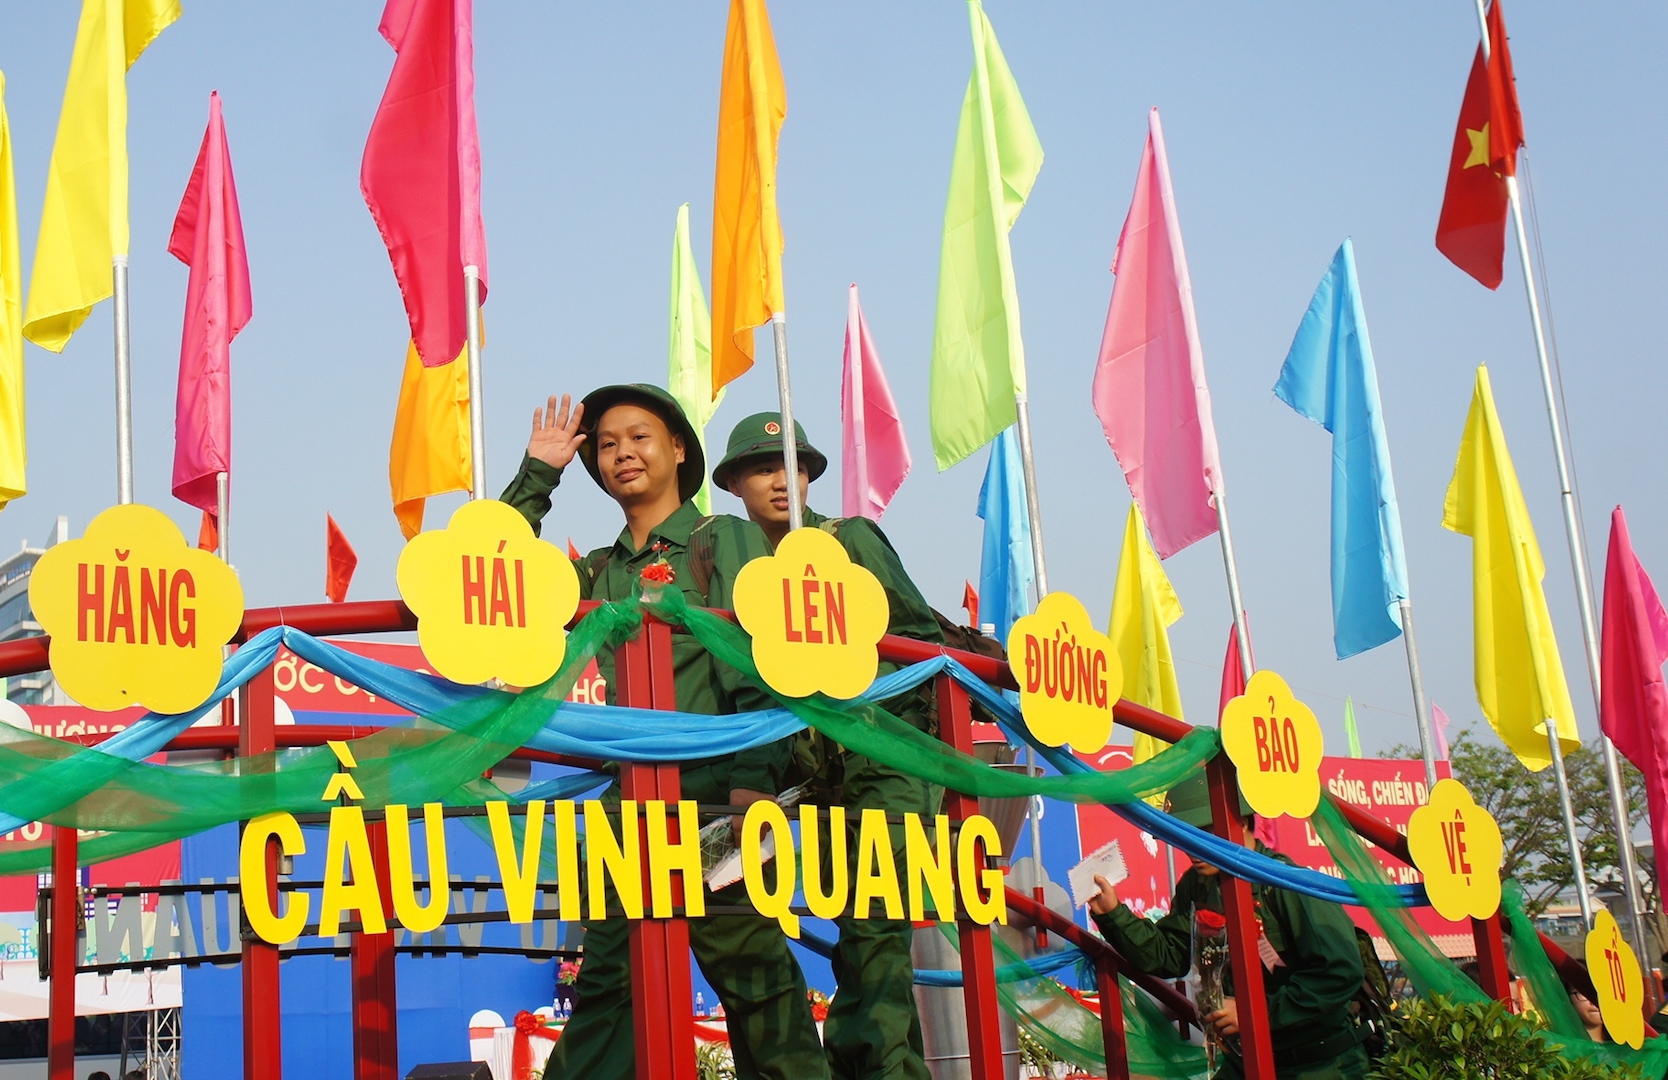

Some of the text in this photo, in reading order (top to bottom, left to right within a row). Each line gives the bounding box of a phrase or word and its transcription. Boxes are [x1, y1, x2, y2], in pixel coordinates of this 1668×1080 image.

[77, 540, 1627, 1004] HĂNG HÁI LÊN ĐƯỜNG BẢO VỆ TỔ
[240, 741, 449, 945] CẦU
[487, 800, 705, 923] VINH
[742, 799, 1008, 938] QUANG
[1372, 771, 1416, 806] CHIẾN
